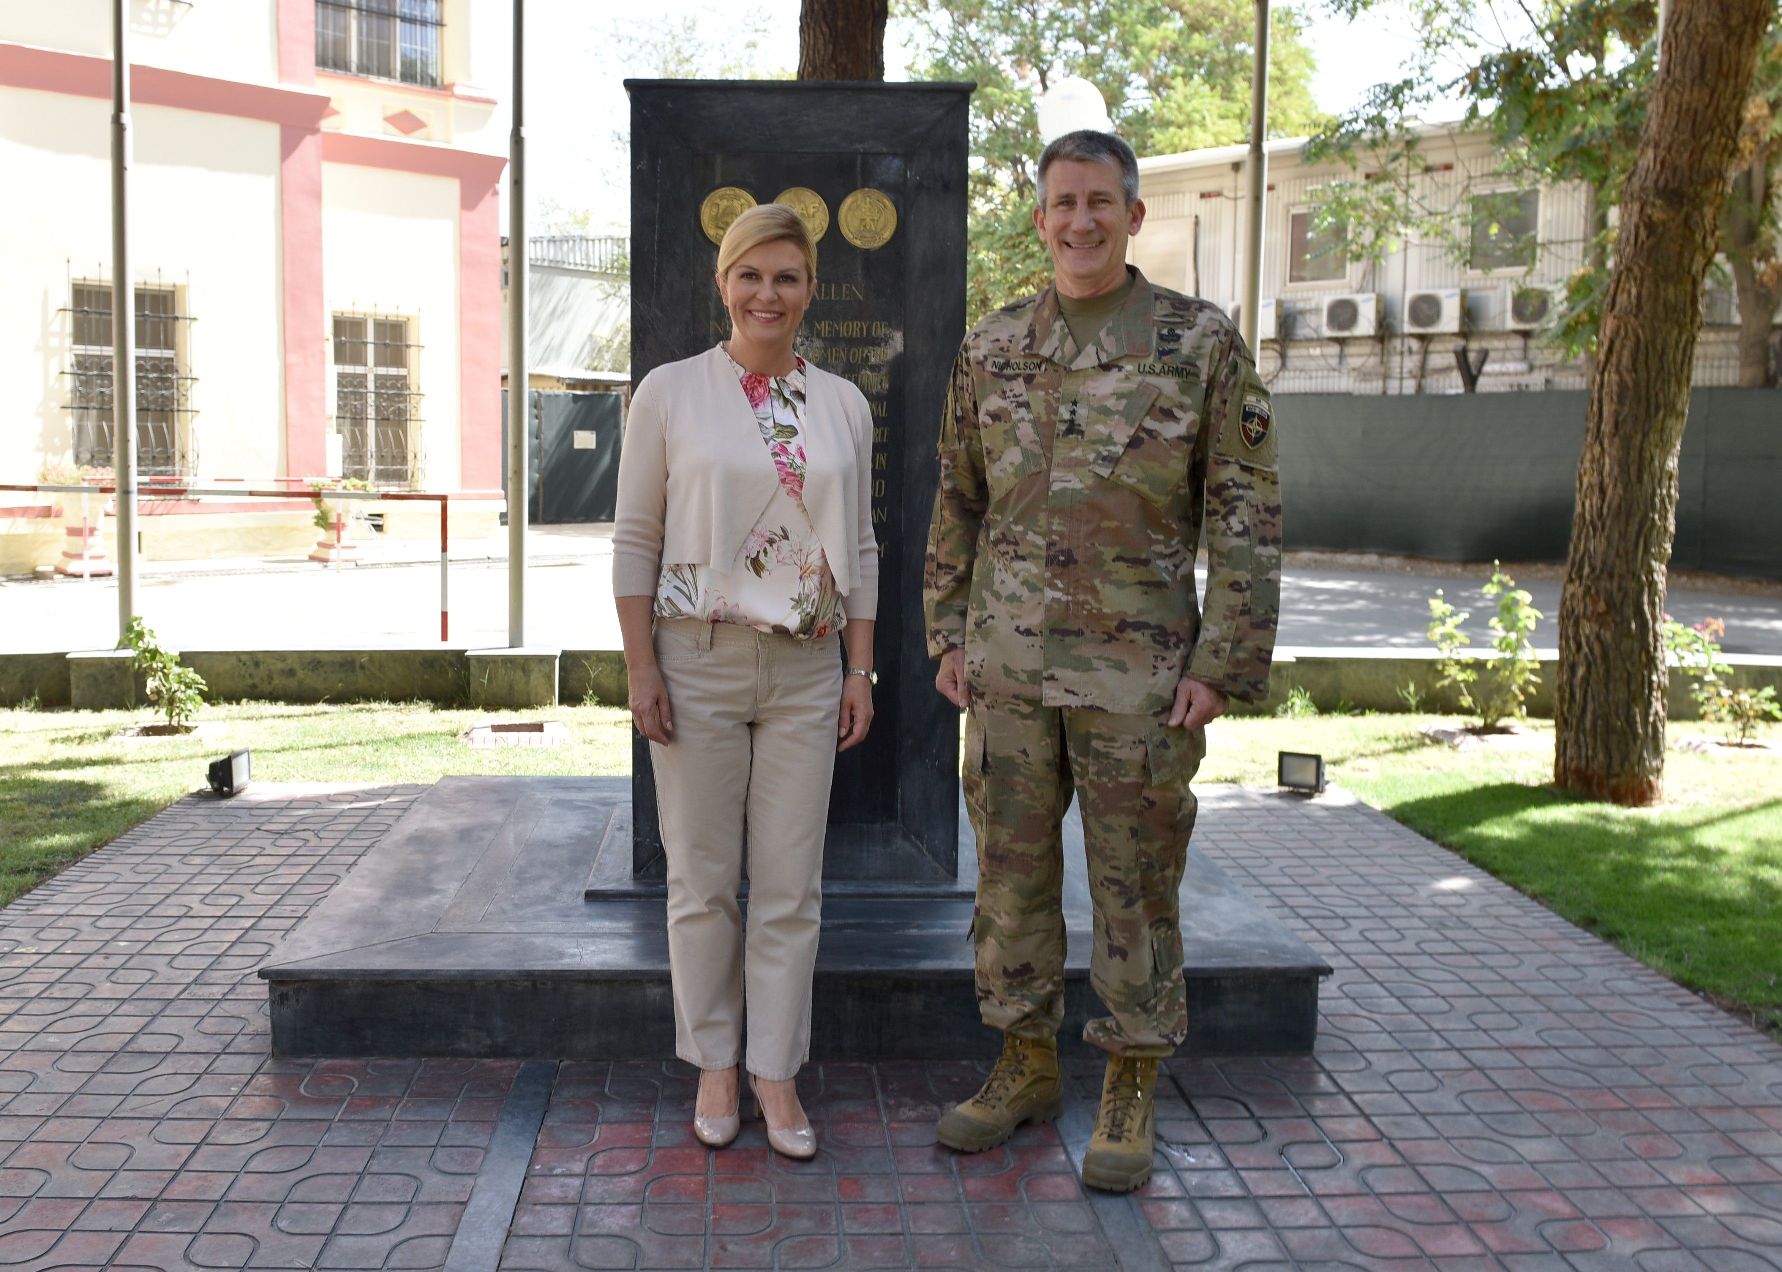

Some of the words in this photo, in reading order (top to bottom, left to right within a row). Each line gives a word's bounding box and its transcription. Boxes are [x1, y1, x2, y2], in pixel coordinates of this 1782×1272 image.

[814, 320, 868, 338] MEMORY
[871, 320, 889, 338] OF
[991, 359, 1043, 372] NICHOLSON
